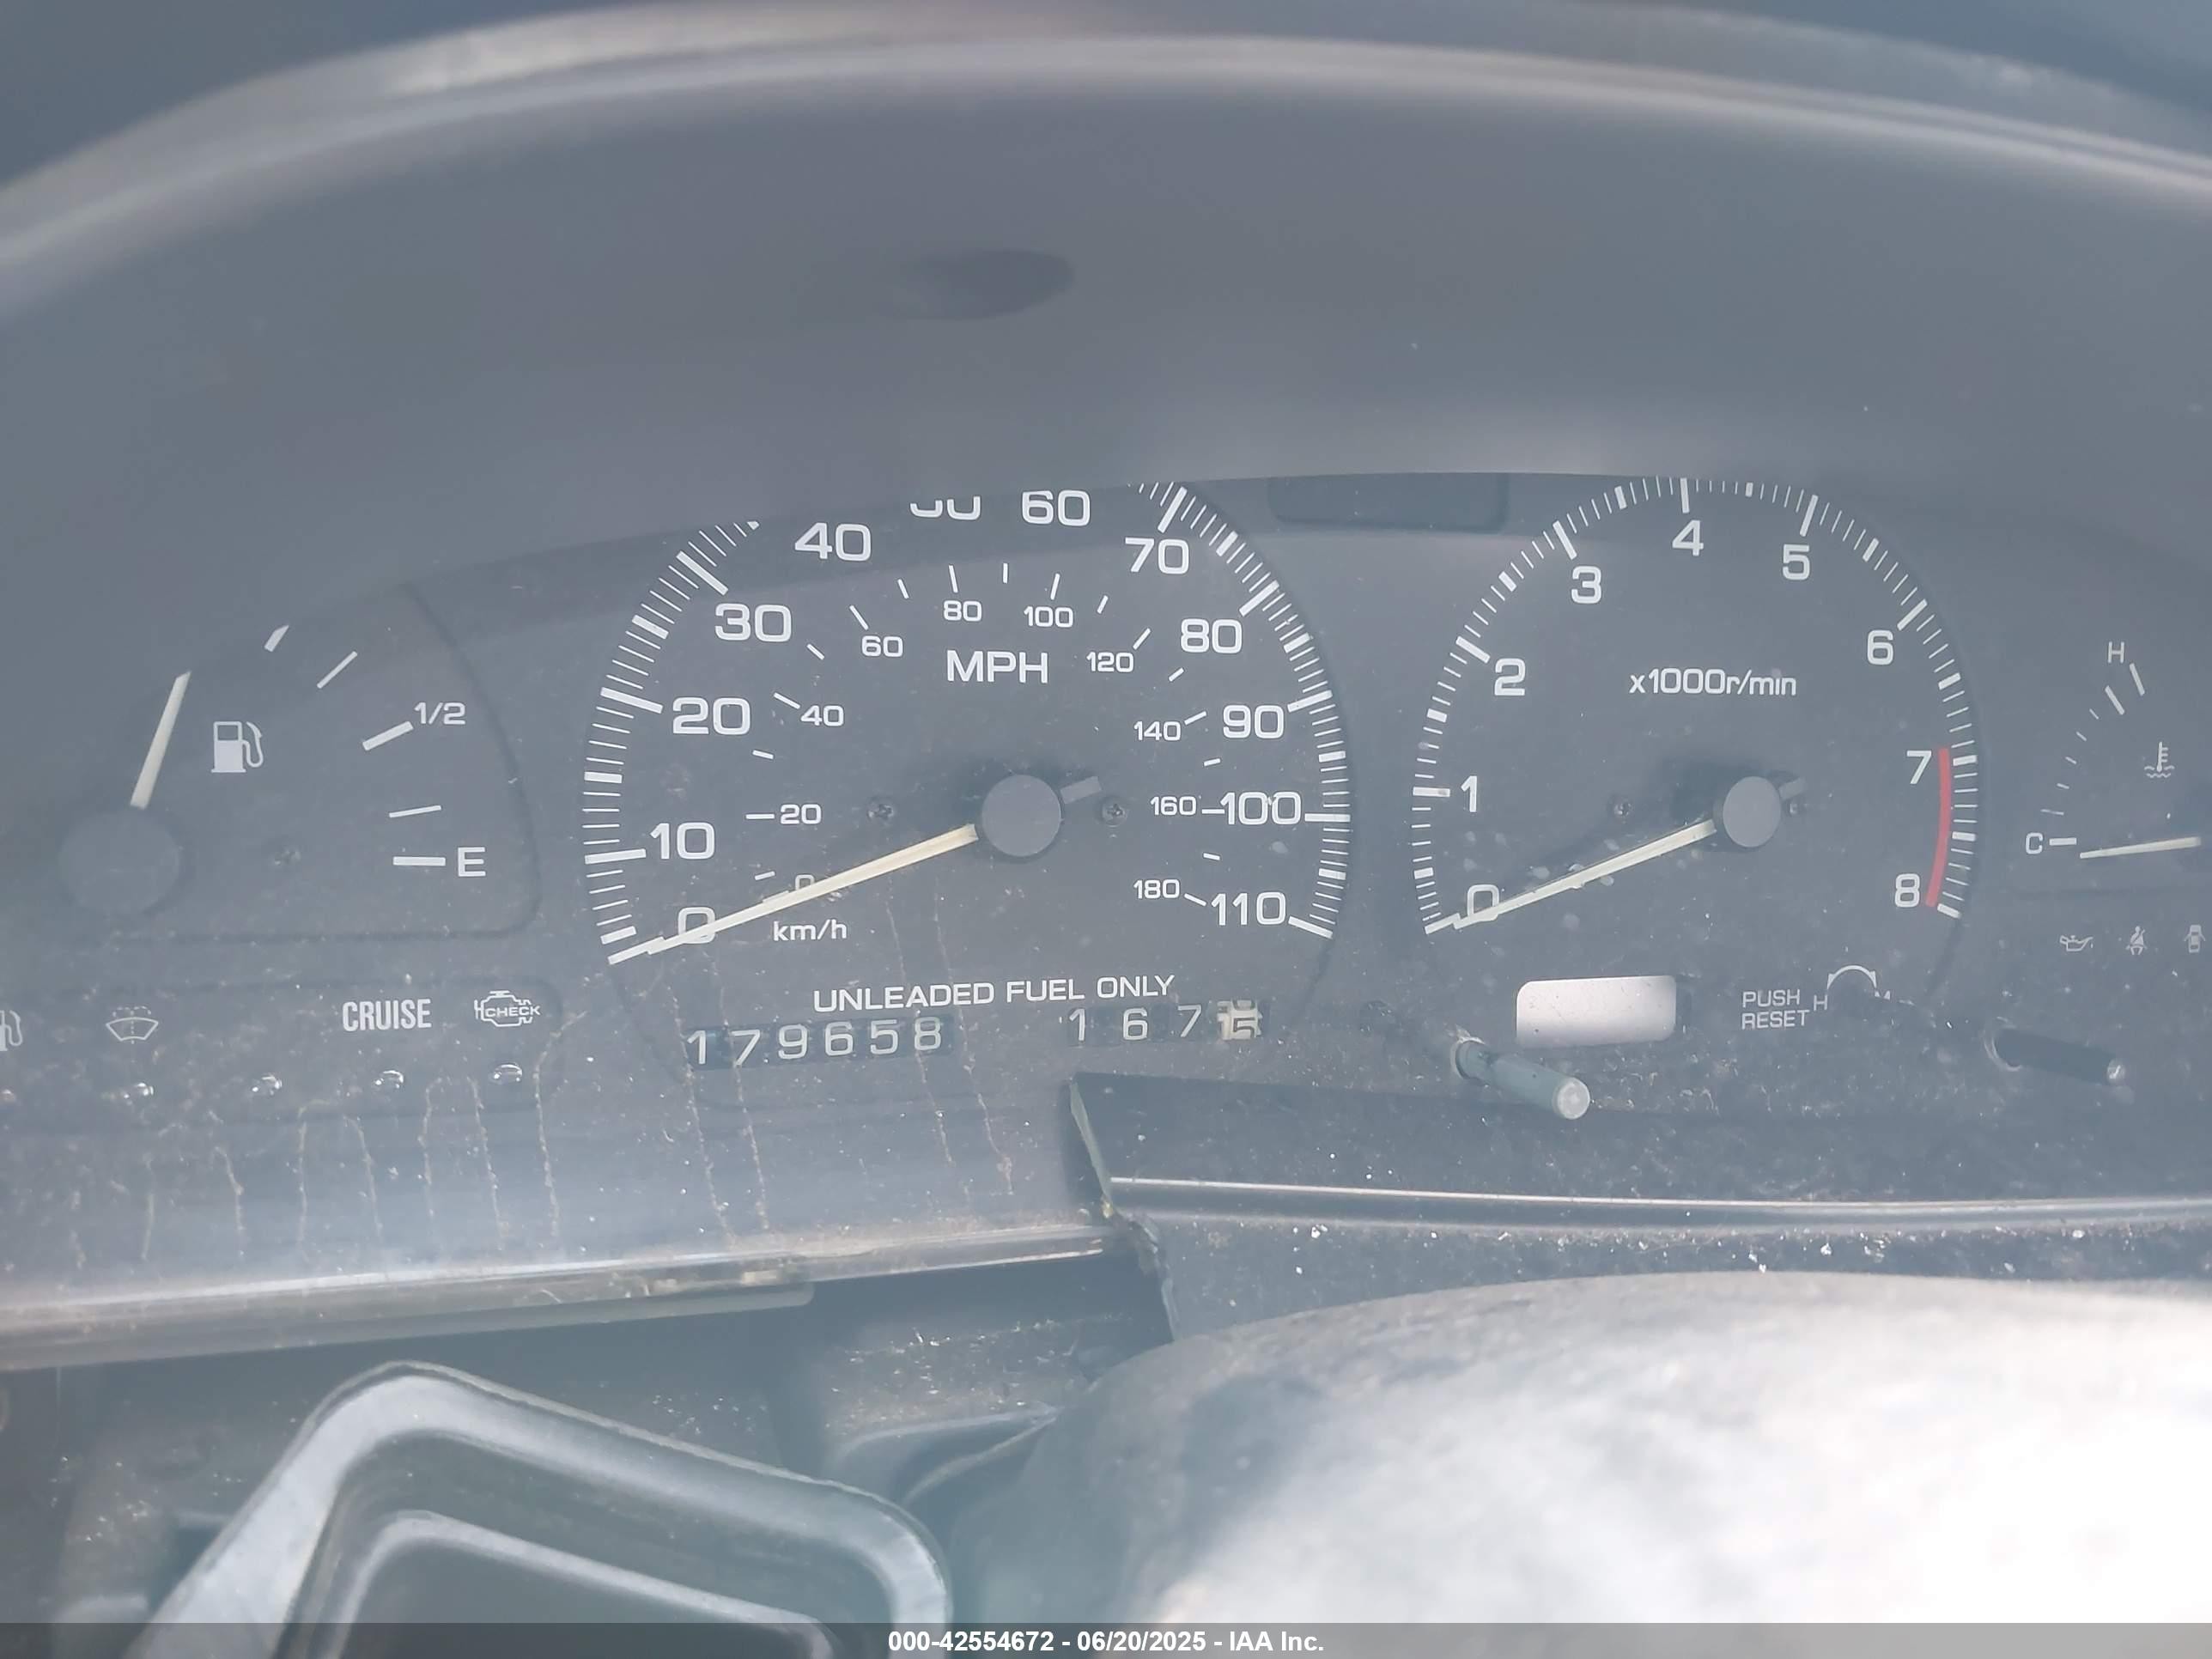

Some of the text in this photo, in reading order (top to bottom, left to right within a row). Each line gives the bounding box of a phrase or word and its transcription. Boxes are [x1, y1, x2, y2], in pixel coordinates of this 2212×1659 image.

[1022, 489, 1091, 526] 60
[794, 522, 872, 562] 40
[1125, 537, 1189, 574] 70
[1672, 520, 1705, 556] 4
[1782, 544, 1810, 580] 5
[1571, 566, 1601, 604] 3
[714, 603, 792, 642] 30
[943, 600, 982, 622] 80
[1024, 605, 1073, 628] 100
[861, 635, 903, 658] 60
[1180, 618, 1243, 653] 80
[1867, 629, 1893, 665] 6
[2107, 641, 2125, 664] H
[946, 649, 1048, 684] MPH
[1086, 651, 1134, 672] 120
[1494, 658, 1526, 696] 2
[1629, 667, 1796, 696] x1000r/min
[414, 702, 466, 725] 1/2
[672, 696, 750, 735] 20
[800, 705, 844, 726] 40
[1133, 720, 1182, 741] 140
[1223, 704, 1285, 739] 90
[1906, 750, 1932, 785] 7
[1150, 796, 1197, 816] 160
[1218, 789, 1304, 828] 100
[1461, 775, 1478, 813] 1
[780, 804, 822, 824] 20
[650, 822, 715, 860] 10
[2025, 832, 2044, 854] C
[458, 847, 486, 878] E
[1133, 878, 1180, 899] 180
[1467, 884, 1500, 921] 0
[1894, 873, 1920, 908] 8
[678, 906, 716, 945] 0
[1211, 891, 1286, 926] 110
[774, 919, 847, 941] km/h
[485, 1005, 540, 1017] CHECK
[814, 975, 1175, 1014] UNLEADED FUEL ONLY
[1742, 988, 1801, 1008] PUSH
[1813, 994, 1828, 1012] H
[342, 999, 432, 1032] CRUISE
[1741, 1009, 1810, 1030] RESET
[688, 1017, 942, 1066] 179658
